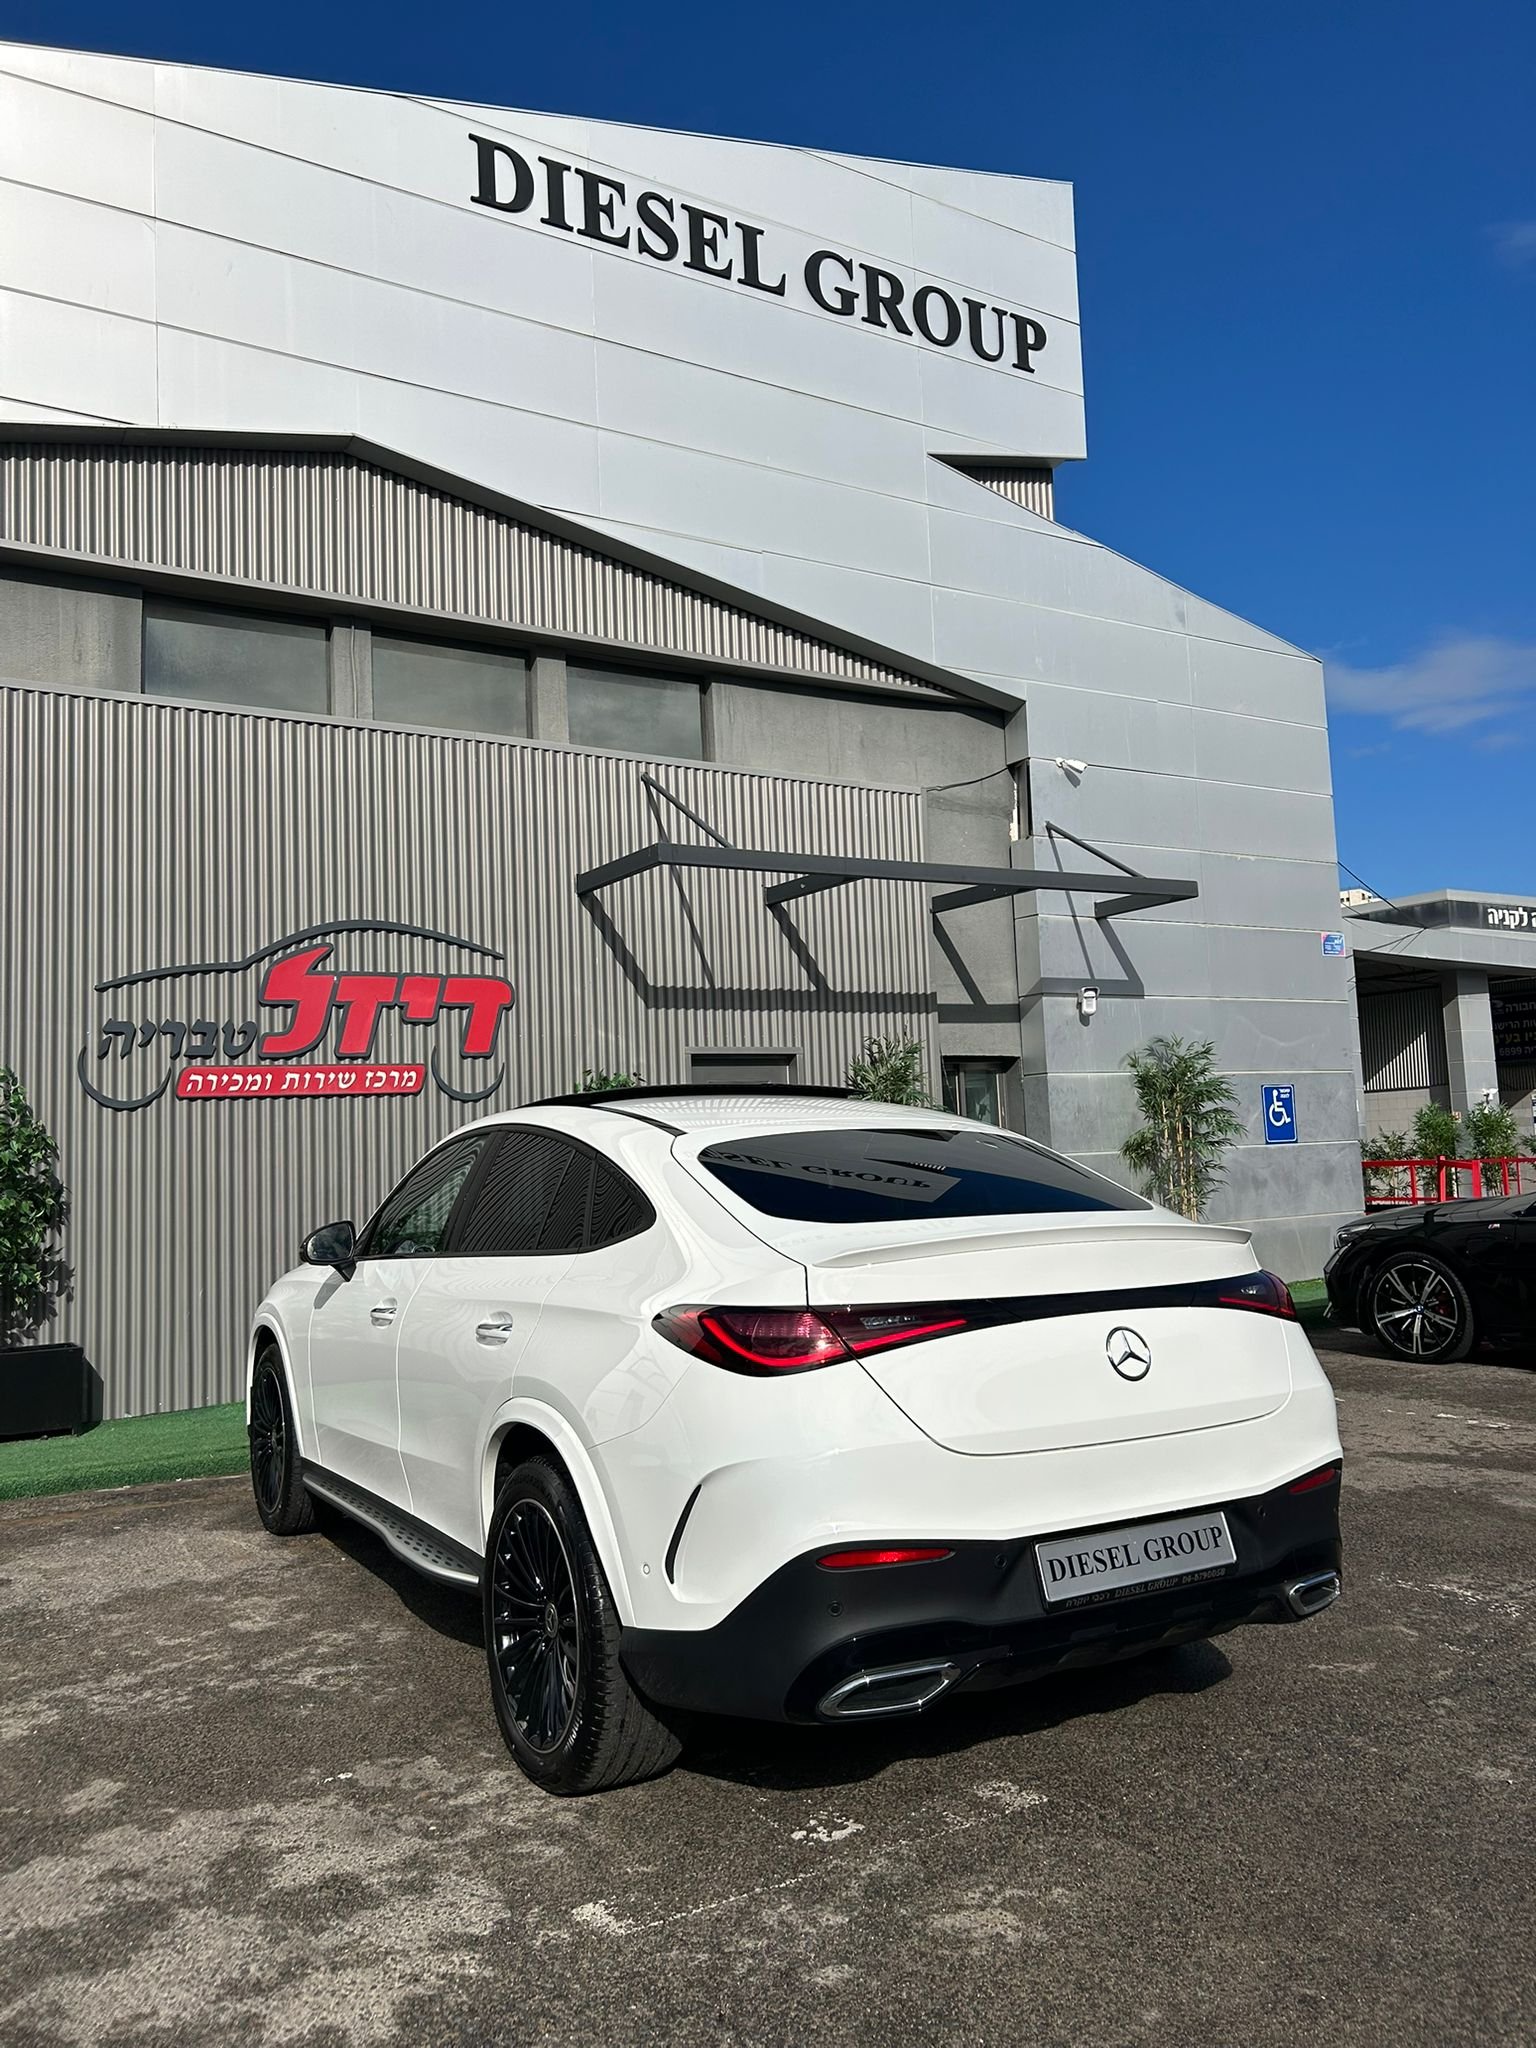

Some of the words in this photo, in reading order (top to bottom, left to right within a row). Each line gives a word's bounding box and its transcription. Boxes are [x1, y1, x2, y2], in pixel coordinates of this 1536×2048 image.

[467, 132, 787, 298] DIESEL
[803, 249, 1048, 374] GROUP
[1487, 906, 1529, 929] לקניה
[258, 942, 515, 1060] דיזל
[97, 1018, 257, 1060] טבריה
[185, 1072, 273, 1093] ומכירה
[282, 1070, 357, 1091] שירות
[364, 1068, 417, 1089] מרכז
[1046, 1543, 1141, 1583] DIESEL
[1143, 1525, 1223, 1562] GROUP
[1114, 1584, 1146, 1598] DIESEL
[1147, 1577, 1179, 1592] GROUP
